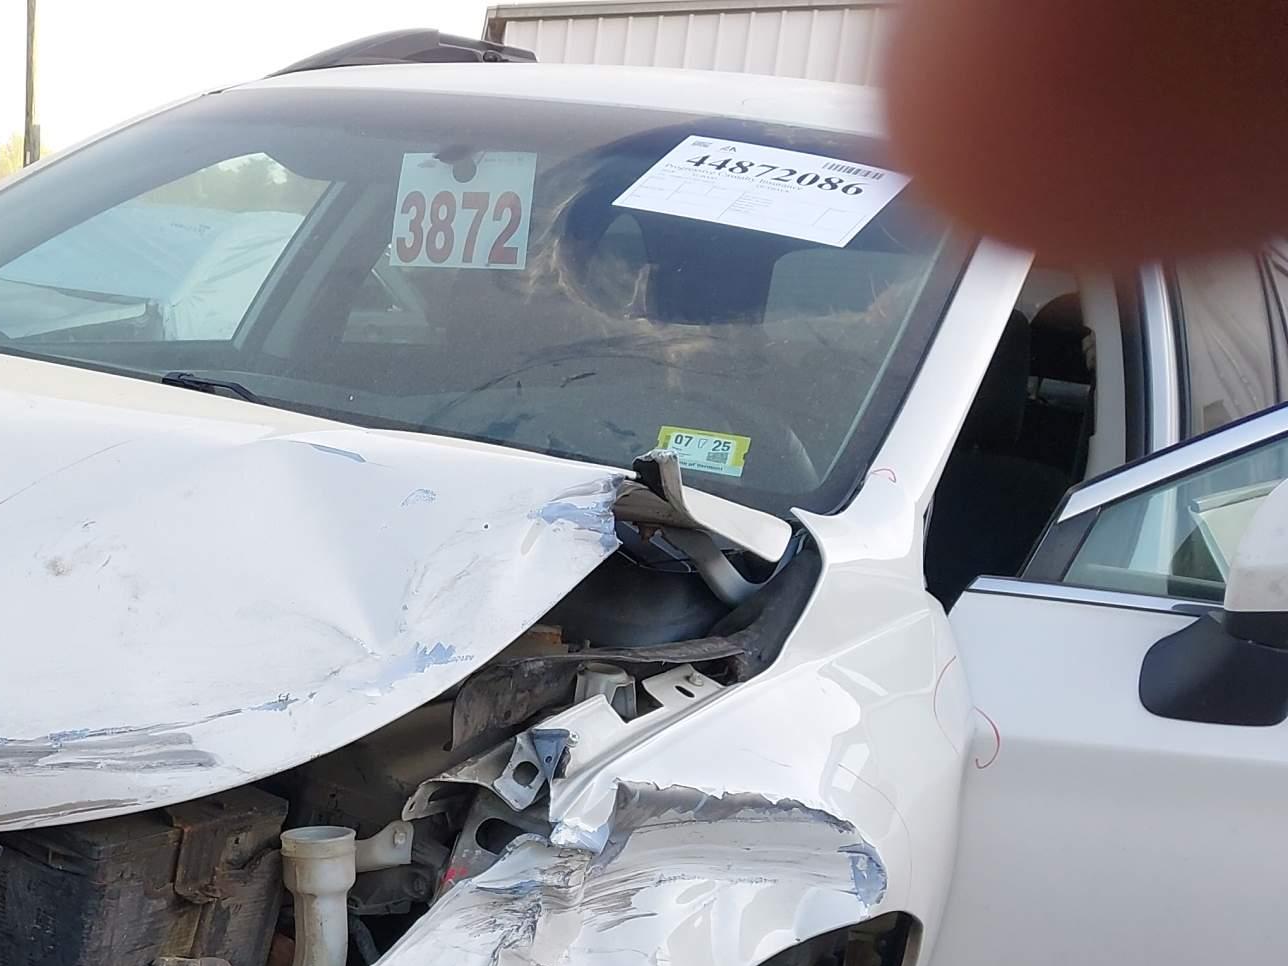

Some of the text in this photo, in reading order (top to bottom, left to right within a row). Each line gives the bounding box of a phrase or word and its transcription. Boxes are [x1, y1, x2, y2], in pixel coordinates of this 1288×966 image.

[686, 154, 869, 196] 44872086
[396, 190, 522, 265] 3872
[674, 433, 732, 452] 07 25
